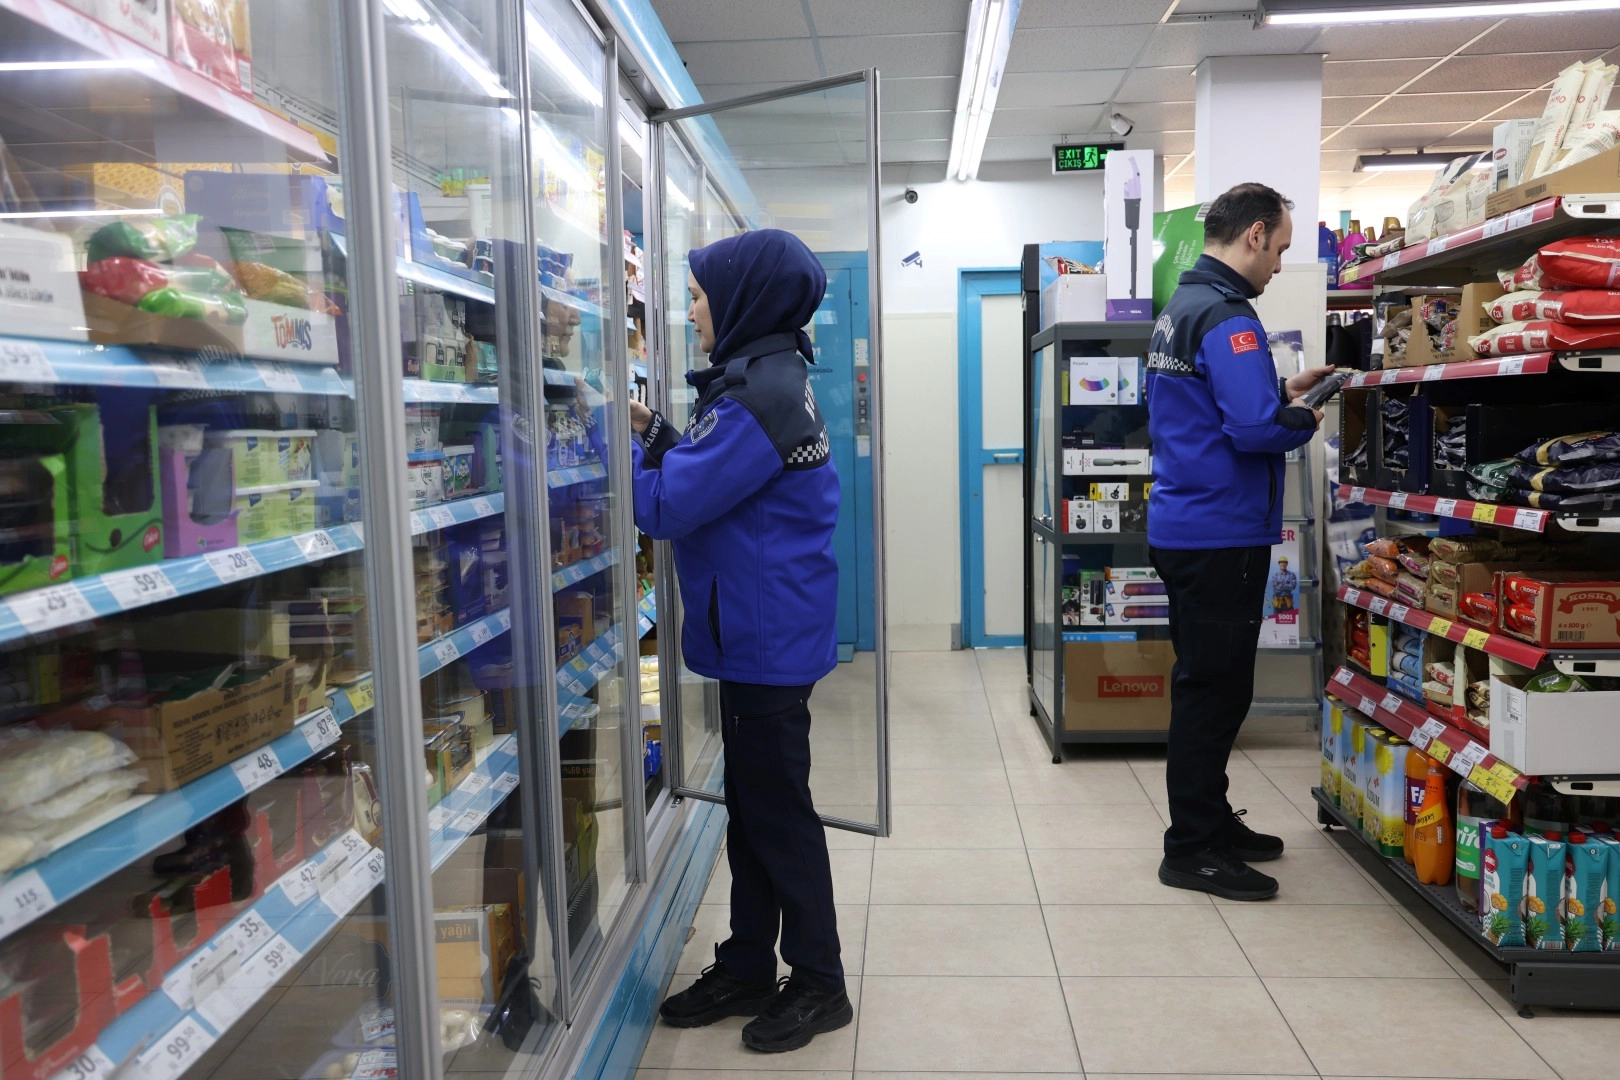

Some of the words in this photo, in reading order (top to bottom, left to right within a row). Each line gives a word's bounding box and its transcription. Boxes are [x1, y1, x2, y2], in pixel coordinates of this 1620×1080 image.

[1554, 125, 1565, 146] RUMMO
[1058, 149, 1081, 159] EXIT
[1058, 160, 1081, 169] ÇIKIŞ
[644, 414, 662, 448] ZABITA
[314, 533, 329, 546] 99
[1280, 530, 1295, 541] ER
[1569, 592, 1614, 602] KOSKA
[1103, 681, 1158, 692] Lenovo
[258, 753, 273, 770] 48
[341, 835, 358, 852] 55
[240, 917, 259, 938] 35
[441, 924, 471, 940] yağlı
[311, 953, 379, 989] Vera
[67, 1054, 96, 1080] 30
